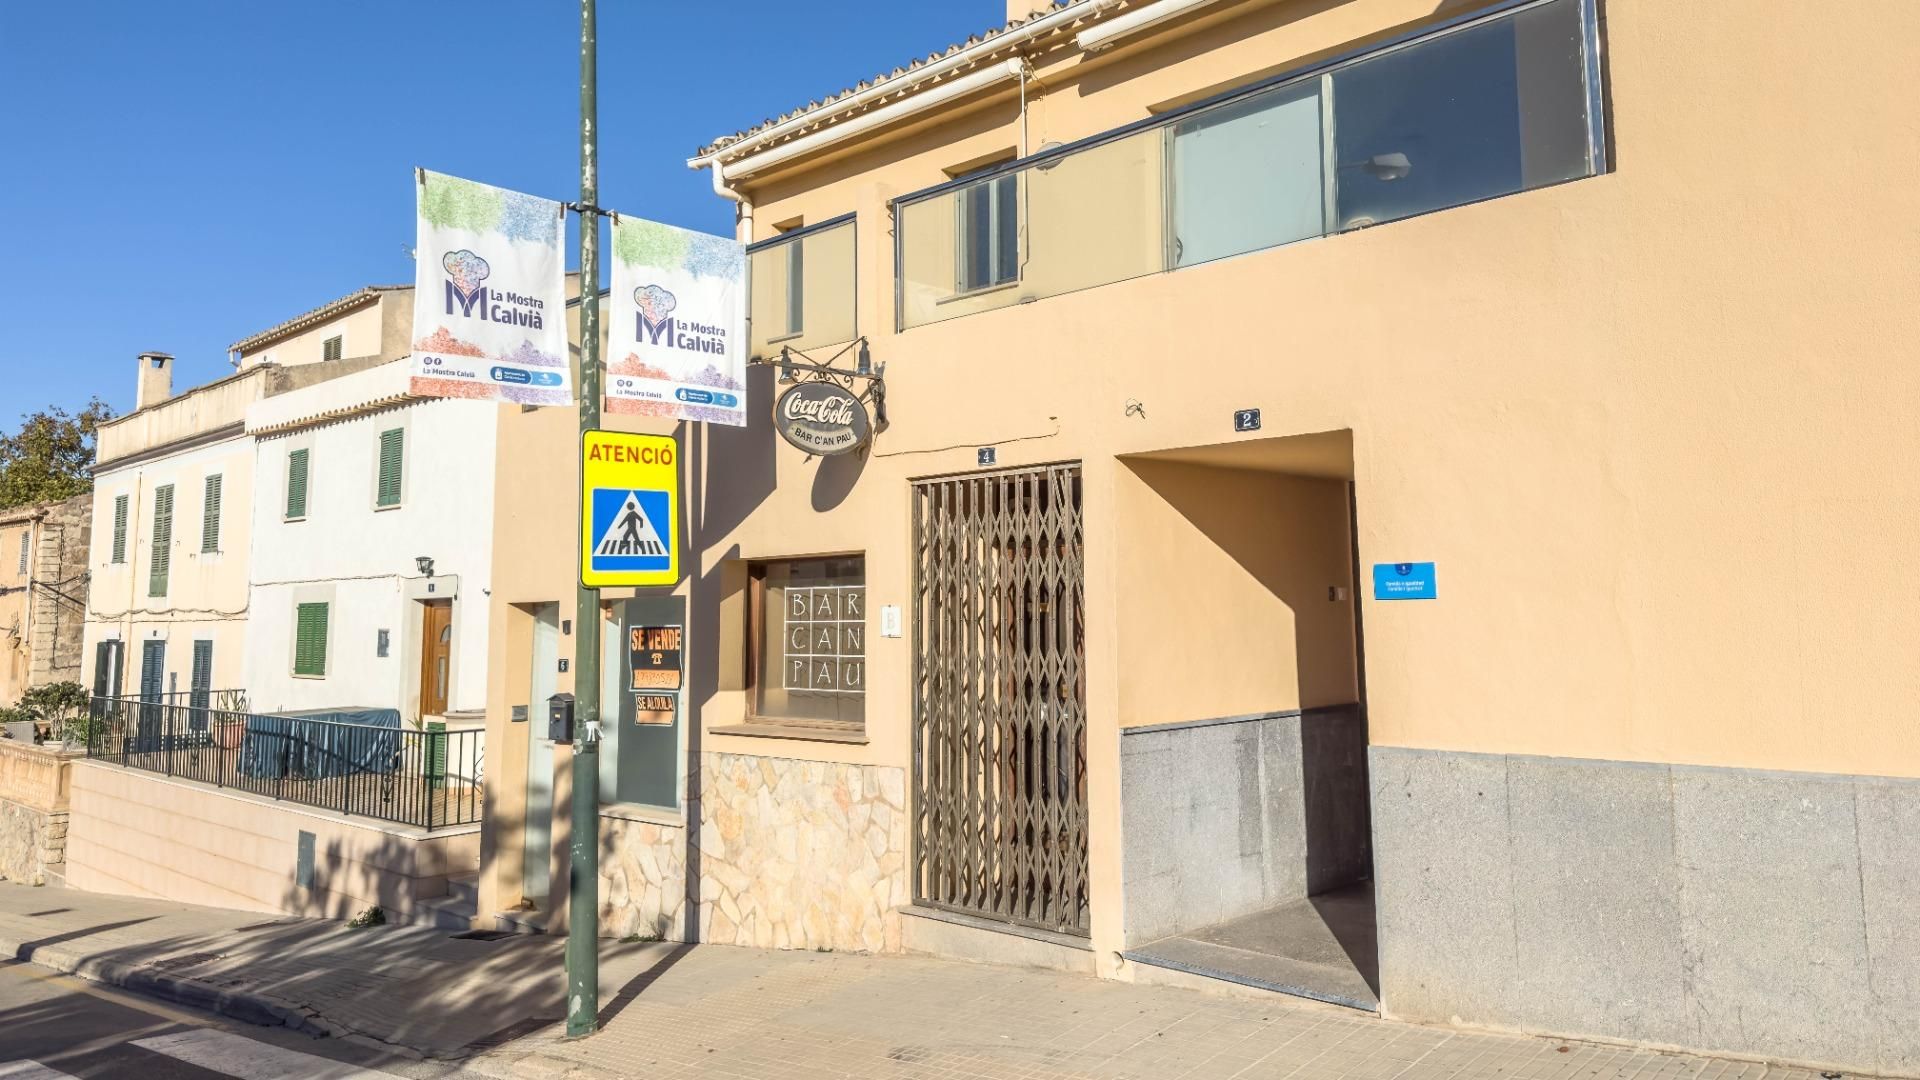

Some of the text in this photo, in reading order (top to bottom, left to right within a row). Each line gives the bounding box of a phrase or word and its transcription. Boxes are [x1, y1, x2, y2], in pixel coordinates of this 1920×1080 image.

[490, 289, 544, 309] La Mostra
[490, 304, 543, 330] Calvià
[676, 320, 726, 337] La Mostra
[676, 333, 725, 356] Calvià
[432, 368, 456, 376] Mostra
[1243, 412, 1252, 427] 2
[794, 427, 852, 446] BAR C'AN PAU
[589, 443, 672, 465] ATENCIÓ
[983, 451, 990, 462] 4
[793, 593, 859, 616] BAR
[632, 628, 681, 651] SE VENDE
[792, 626, 860, 650] CAN
[793, 660, 860, 686] PAU
[638, 696, 646, 710] SE
